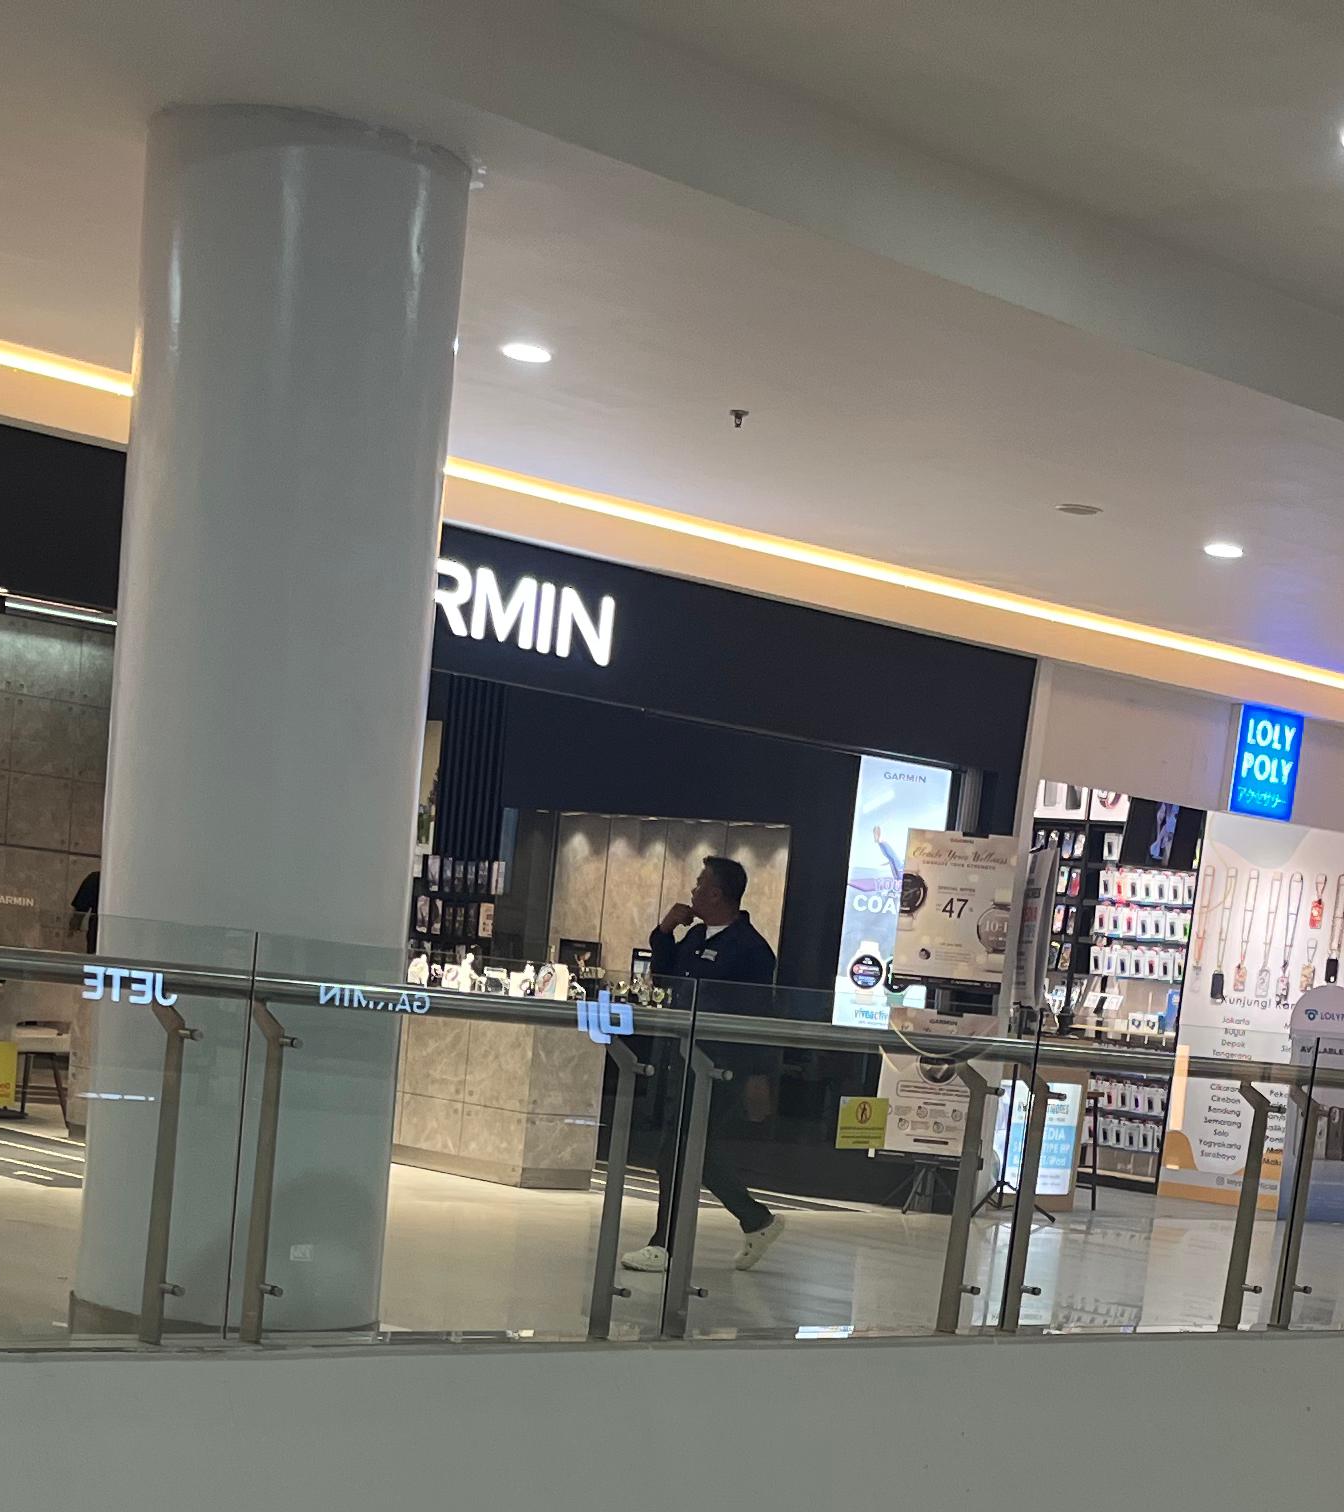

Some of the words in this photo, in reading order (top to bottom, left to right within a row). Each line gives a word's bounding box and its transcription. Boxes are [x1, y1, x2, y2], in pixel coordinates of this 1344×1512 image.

[1247, 718, 1297, 751] LOLY
[883, 771, 927, 784] GARMIN
[1241, 751, 1294, 785] POLY
[941, 897, 969, 919] 47
